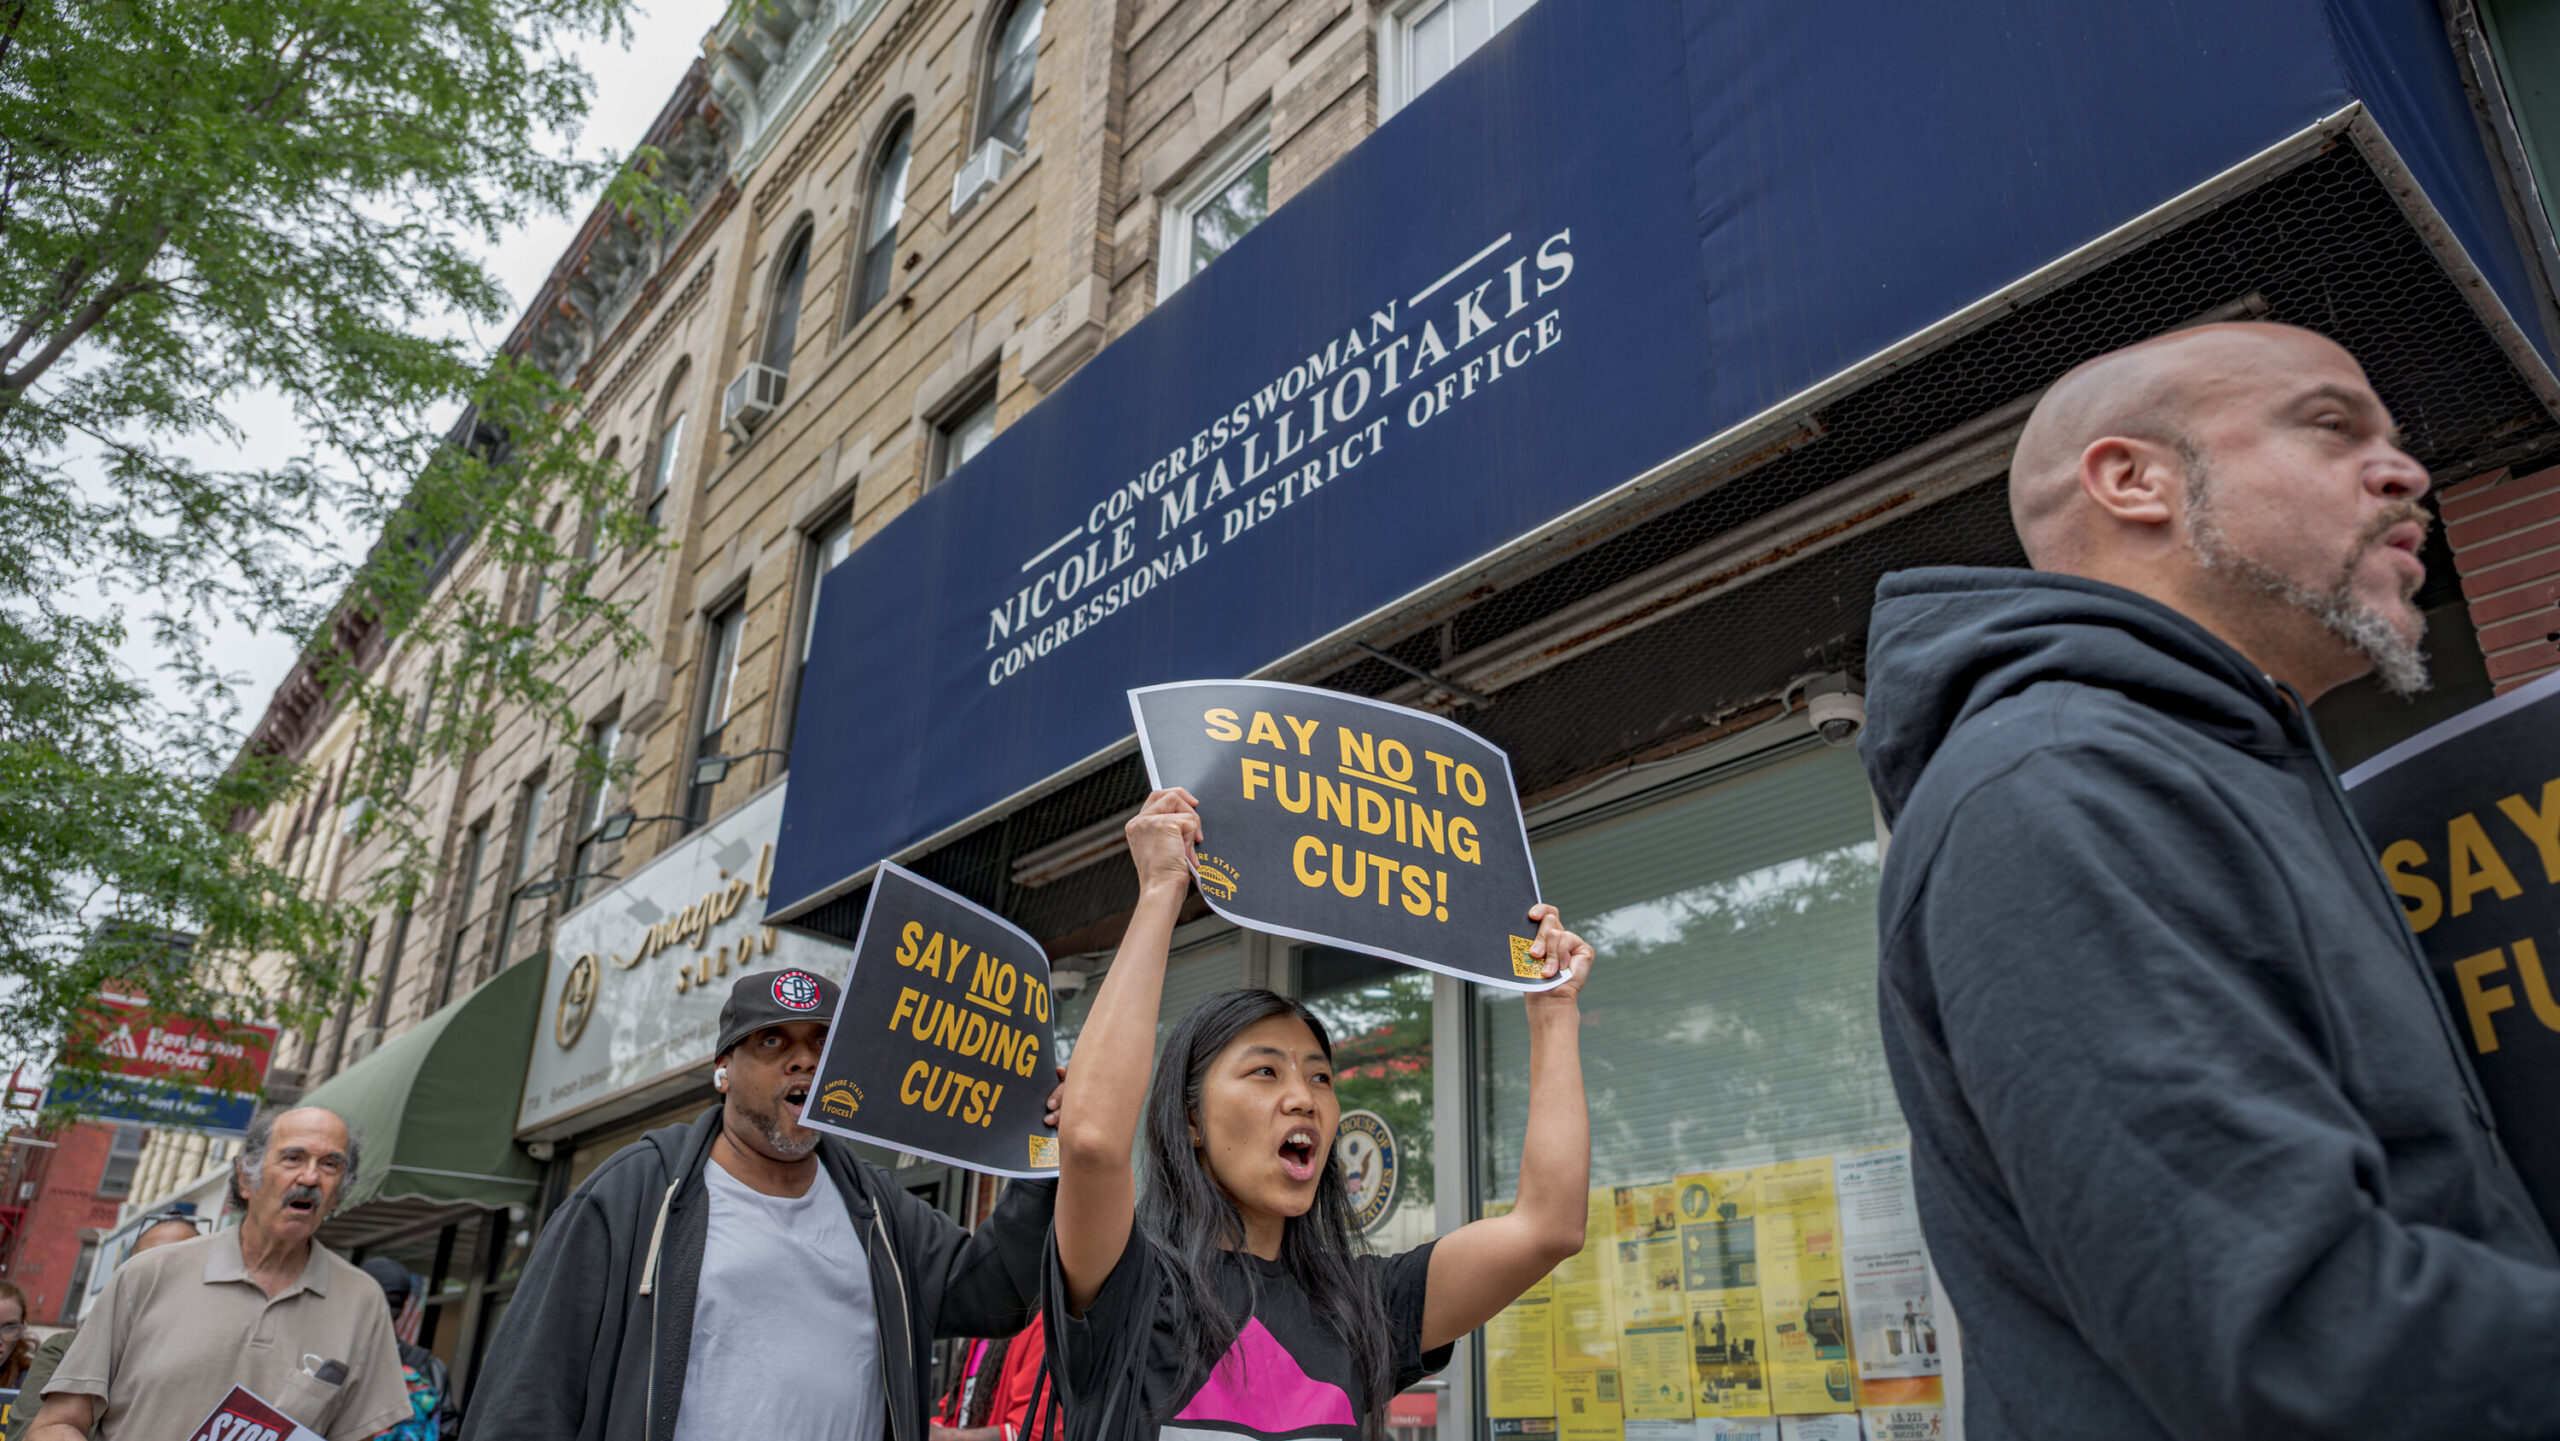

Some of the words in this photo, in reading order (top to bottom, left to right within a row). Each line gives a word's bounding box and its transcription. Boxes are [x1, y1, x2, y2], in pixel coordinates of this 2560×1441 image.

[986, 516, 1136, 650] NICOLE
[1157, 227, 1574, 540] MALLIOTAKIS
[1088, 299, 1397, 534] CONGRESSWOMAN
[988, 531, 1208, 686] CONGRESSIONAL
[1222, 415, 1389, 544] DISTRICT
[1407, 309, 1562, 428] OFFICE
[1204, 708, 1320, 756] SAY
[1338, 726, 1414, 783] NO
[1425, 750, 1487, 807] TO
[1241, 757, 1482, 865] FUNDING
[2379, 777, 2560, 934] SAY
[1201, 883, 1226, 899] OICES
[1213, 856, 1240, 880] STATE
[1292, 835, 1449, 923] CUTS!
[676, 926, 776, 994] SALON
[895, 920, 971, 984] SAY
[970, 951, 1017, 1006] NO
[1023, 972, 1049, 1024] TO
[888, 986, 1040, 1078] FUNDING
[827, 1105, 849, 1117] VOICES
[900, 1060, 1004, 1128] CUTS!
[1341, 1116, 1378, 1135] HOUSE
[1375, 1130, 1391, 1150] OF
[197, 1412, 282, 1441] ST
